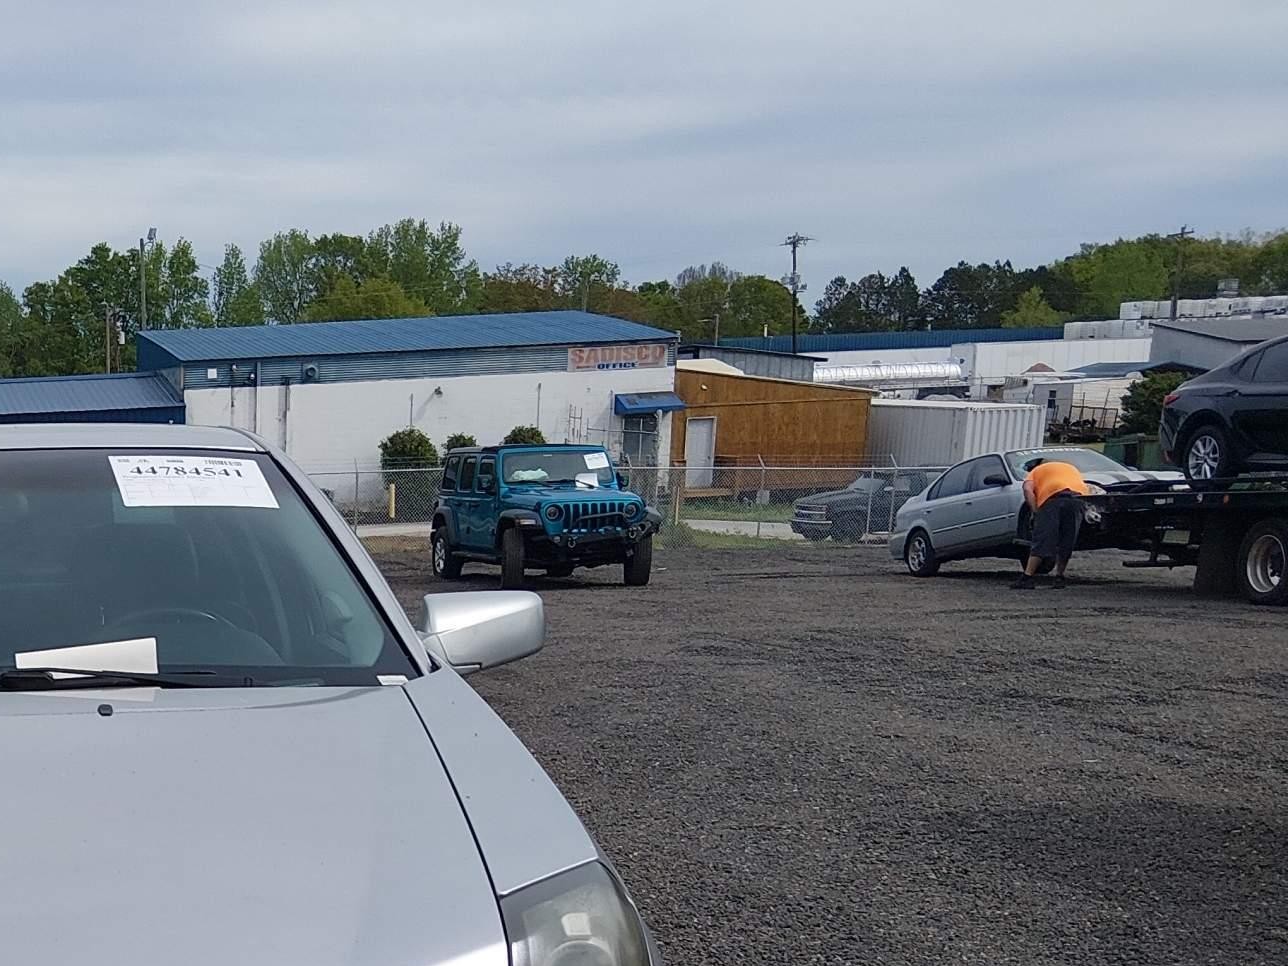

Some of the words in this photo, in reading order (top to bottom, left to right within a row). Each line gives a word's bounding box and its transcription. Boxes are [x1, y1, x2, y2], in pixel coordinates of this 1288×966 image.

[571, 345, 666, 364] SADISCO
[596, 362, 638, 370] OFFICE
[130, 465, 243, 478] 44784541
